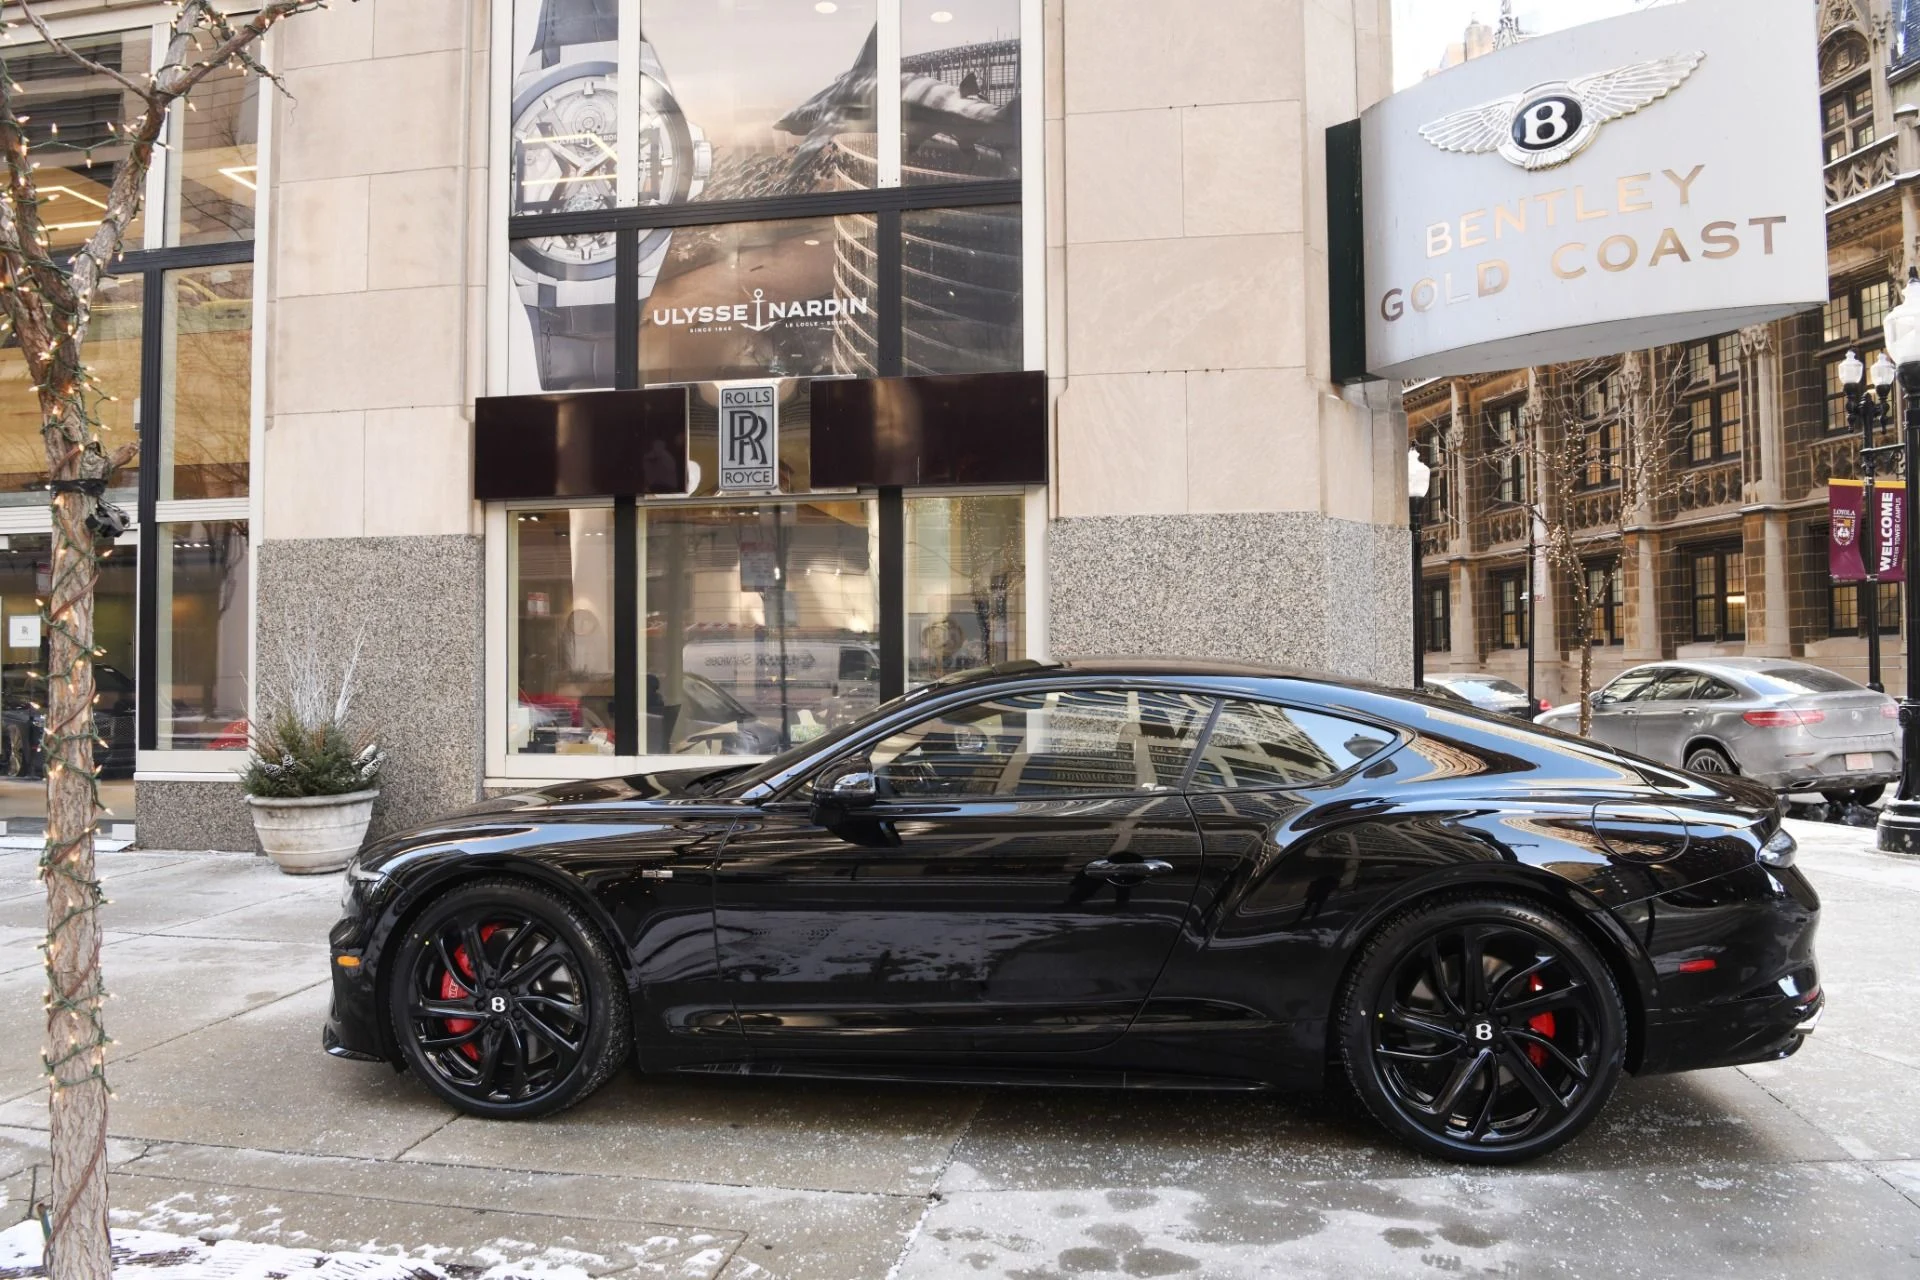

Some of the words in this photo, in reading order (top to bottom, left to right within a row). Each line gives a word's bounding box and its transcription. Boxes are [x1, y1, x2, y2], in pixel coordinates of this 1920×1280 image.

[1523, 100, 1568, 145] B
[1425, 164, 1706, 259] BENTLEY
[1380, 258, 1510, 322] GOLD
[1551, 215, 1787, 280] COAST
[653, 304, 748, 326] ULYSSE
[768, 297, 868, 319] NARDIN
[725, 390, 771, 404] ROLLS
[725, 471, 771, 484] ROYCE
[1880, 492, 1893, 571] WELCOME
[491, 996, 506, 1012] B
[1475, 1023, 1493, 1040] B
